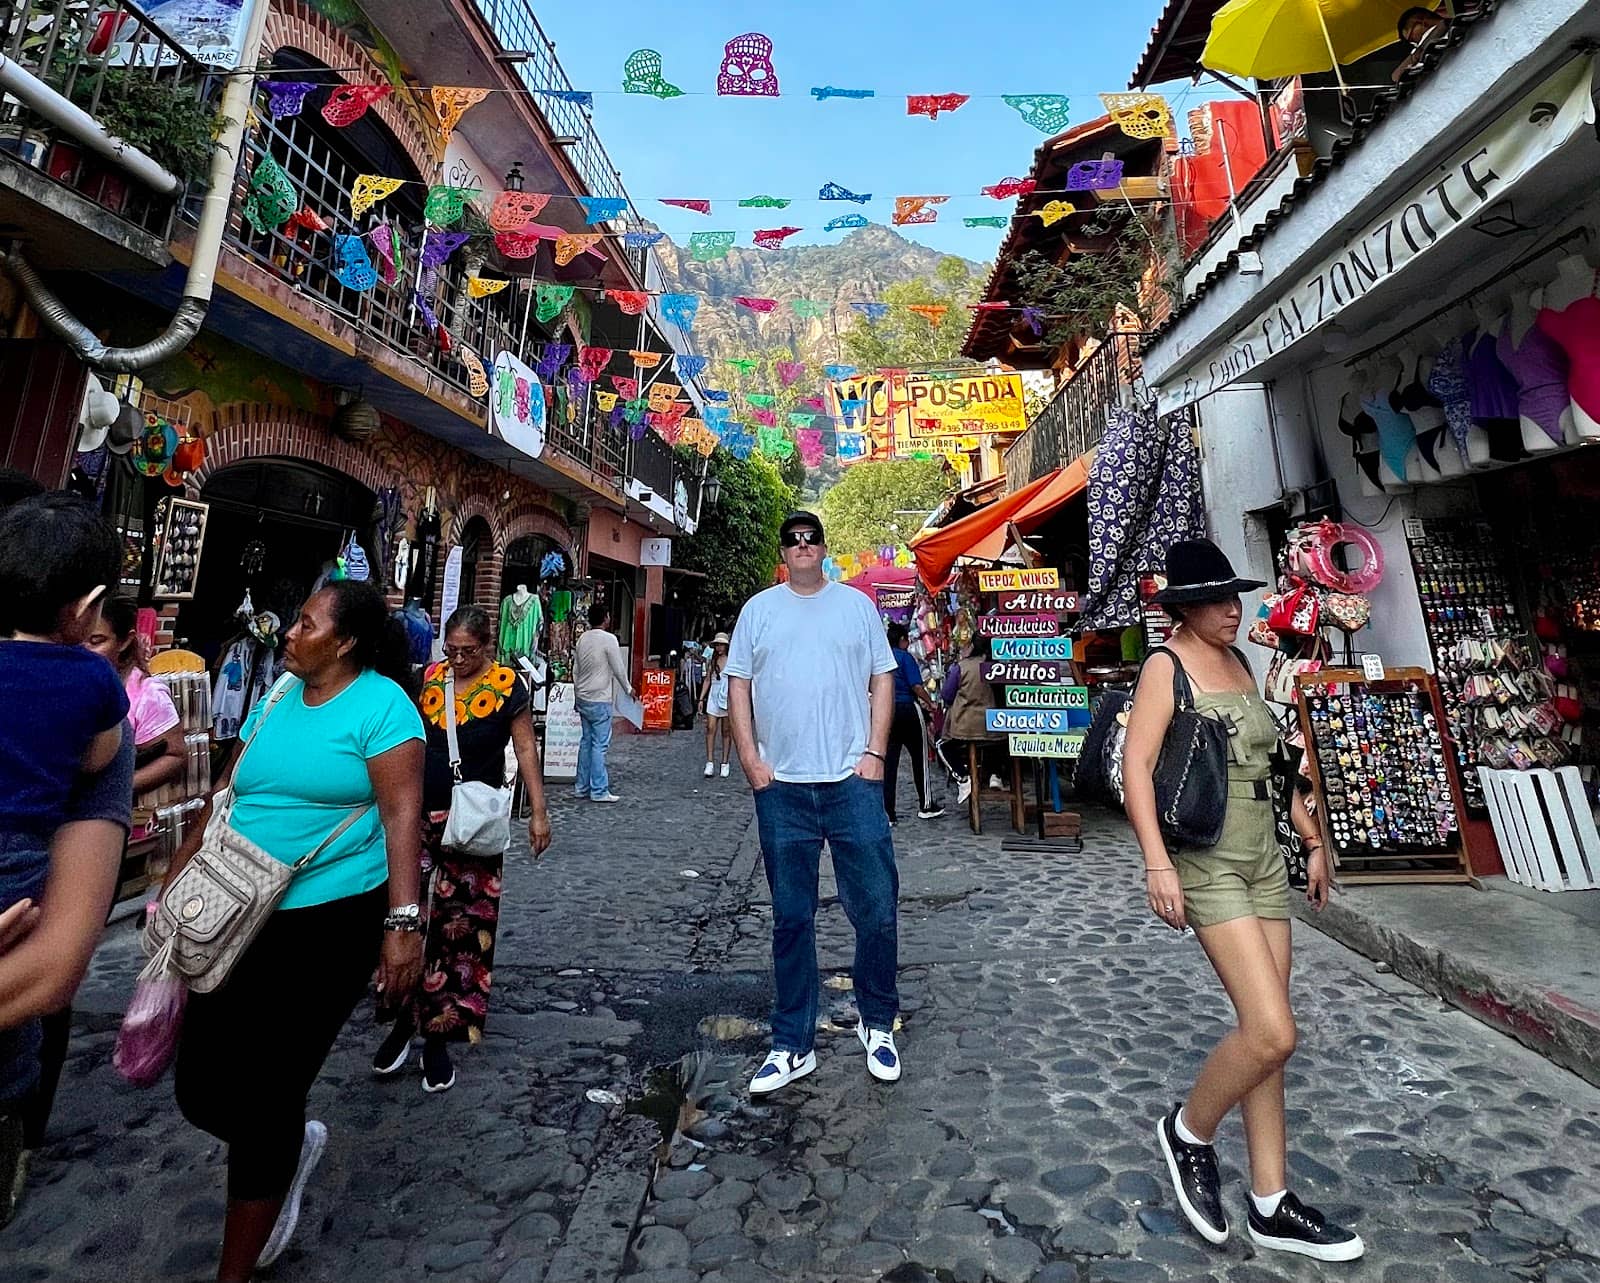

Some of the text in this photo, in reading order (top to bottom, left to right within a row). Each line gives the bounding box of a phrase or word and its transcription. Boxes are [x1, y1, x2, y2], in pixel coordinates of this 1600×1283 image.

[911, 379, 1017, 408] POSADA
[984, 421, 999, 431] 395
[897, 439, 954, 449] TIEMPO LIBRE
[981, 571, 1056, 587] TEPOZ WINGS
[1005, 593, 1076, 610] Alitas
[994, 639, 1067, 658] Mojitos
[985, 662, 1057, 680] Pitufos
[1007, 687, 1085, 707] Cantaritos
[1012, 735, 1046, 754] Tequila
[1054, 737, 1082, 754] Mezc
